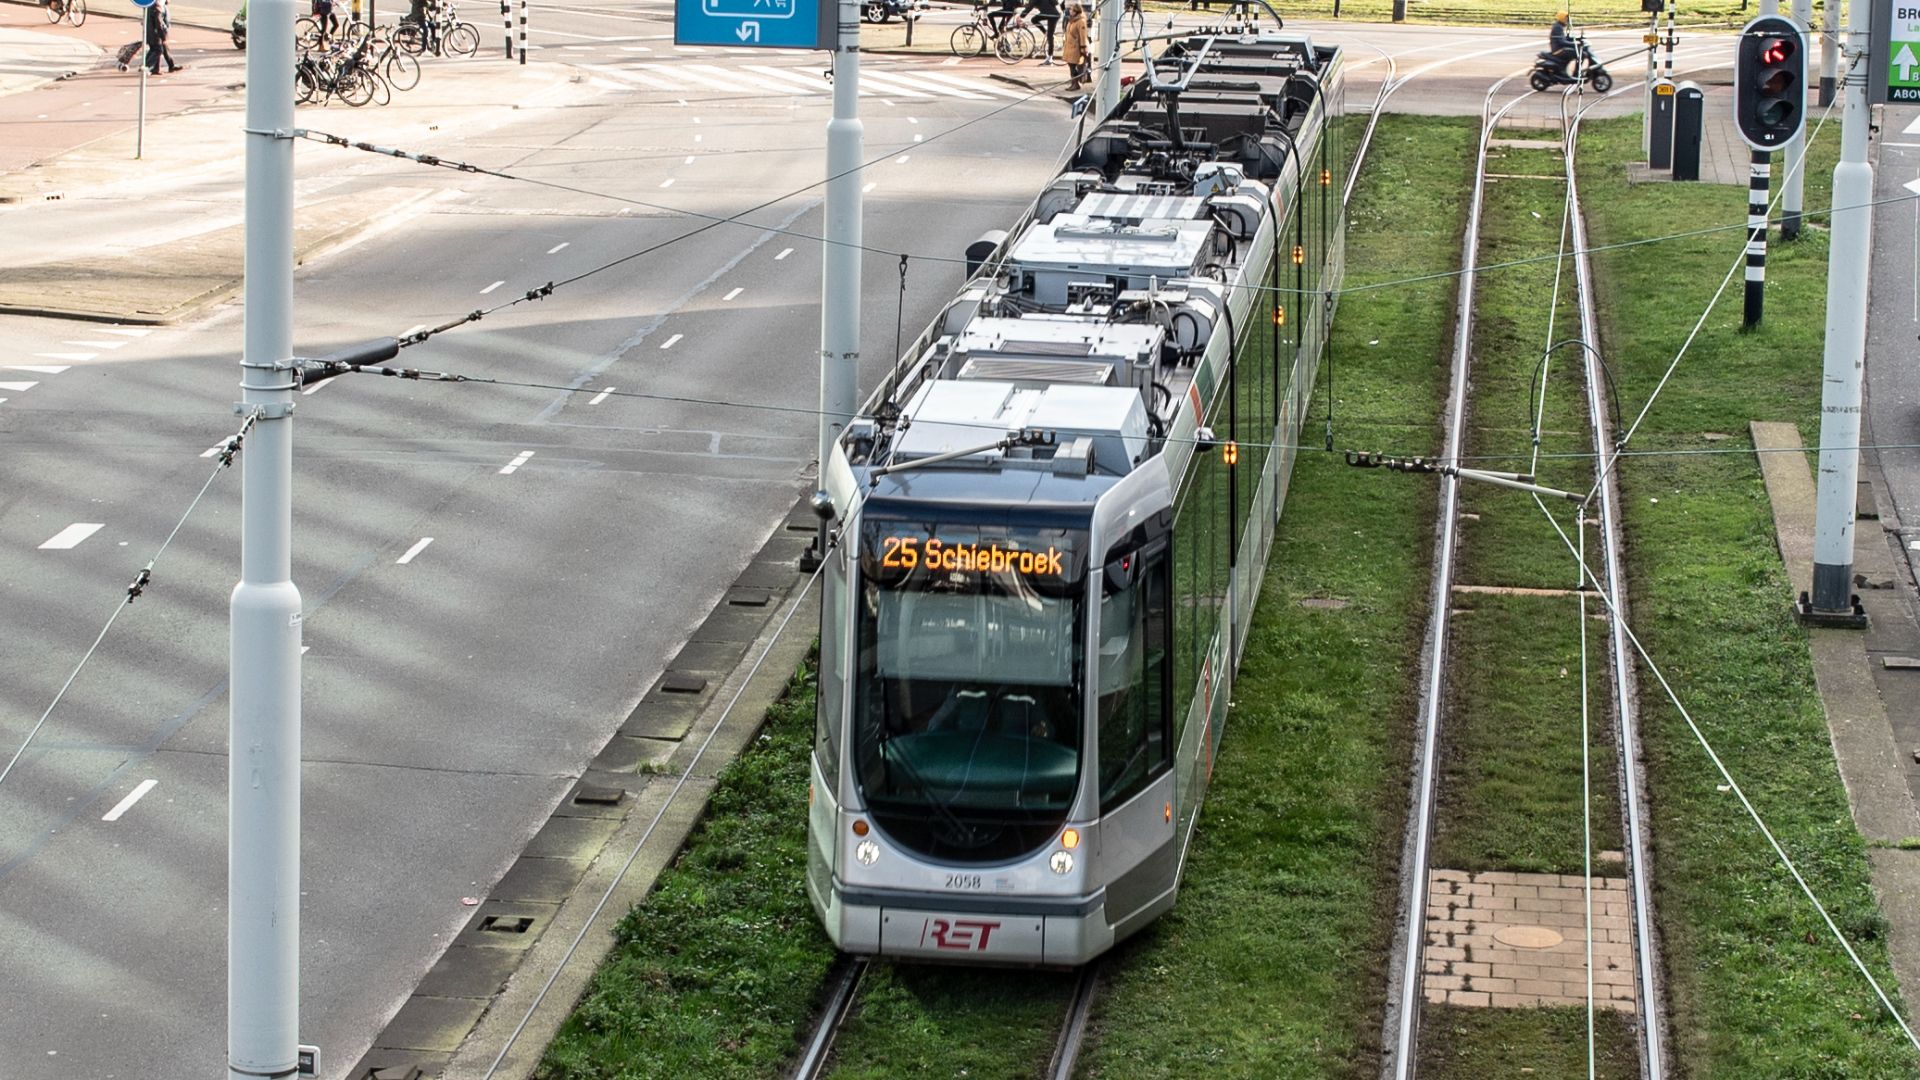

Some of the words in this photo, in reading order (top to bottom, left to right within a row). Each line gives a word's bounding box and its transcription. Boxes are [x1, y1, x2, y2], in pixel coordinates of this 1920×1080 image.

[1897, 7, 1920, 20] BR
[883, 537, 918, 568] 25
[925, 538, 1063, 576] Schiebroek
[945, 873, 982, 889] 2058
[930, 918, 1002, 951] RET
